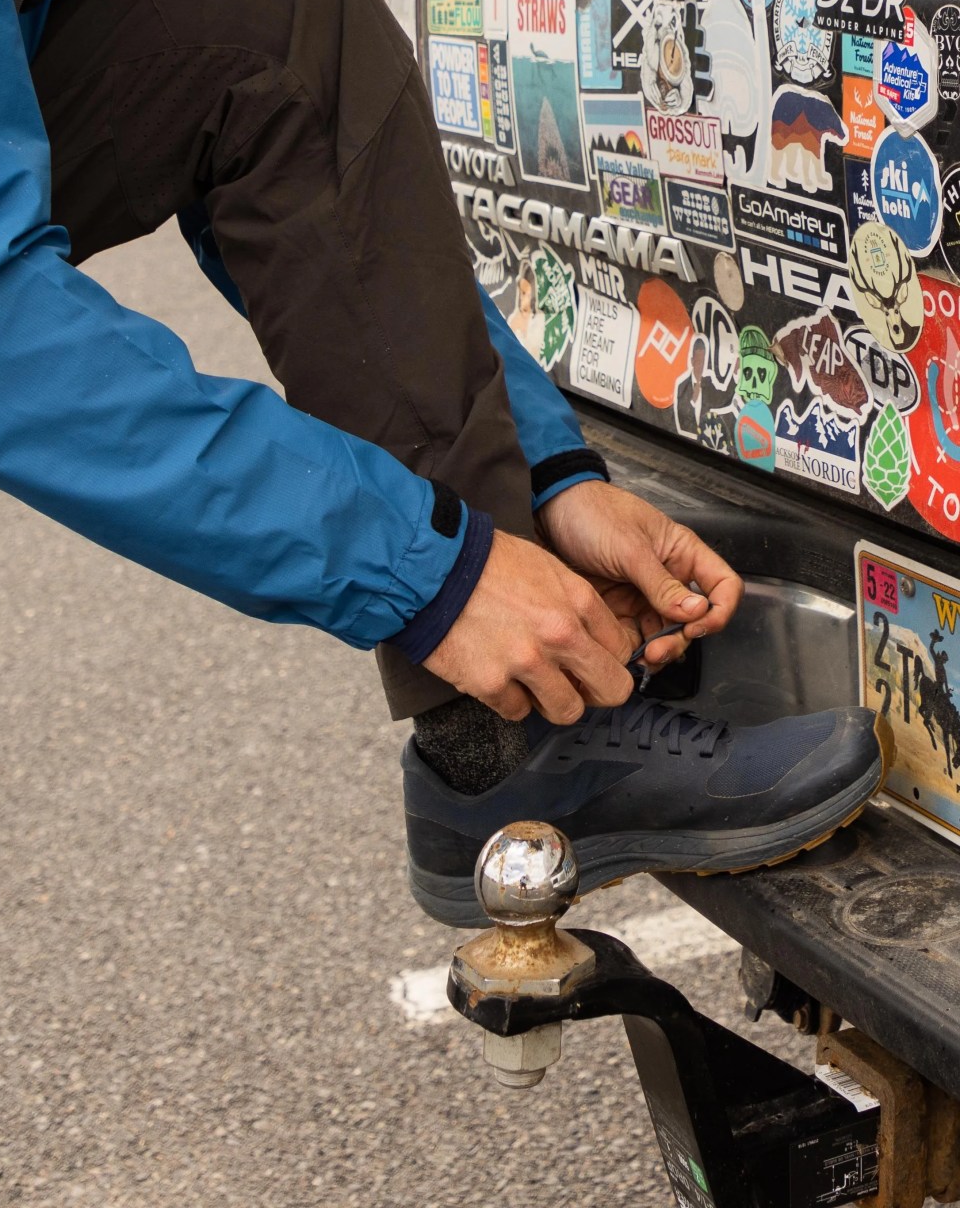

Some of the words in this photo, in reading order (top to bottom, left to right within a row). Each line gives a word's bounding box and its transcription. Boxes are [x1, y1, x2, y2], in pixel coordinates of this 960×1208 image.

[816, 15, 859, 32] WONDER
[865, 24, 903, 40] ALPINE
[431, 42, 475, 75] POWDER
[883, 61, 917, 80] Adventure
[437, 70, 451, 98] TO
[452, 74, 472, 103] THE
[883, 72, 912, 89] Medical
[903, 89, 915, 101] Kits
[649, 114, 717, 149] GROSSOUT
[850, 111, 877, 128] National
[853, 125, 874, 141] Forest
[441, 140, 516, 186] TOYOTA
[597, 156, 623, 176] Magic
[625, 160, 655, 180] Valley
[880, 159, 909, 193] ski
[609, 179, 655, 211] GEAR
[681, 190, 711, 213] RIDE
[881, 195, 911, 219] hoth
[672, 205, 730, 236] WYOMING
[738, 193, 836, 239] GoAmateur
[451, 181, 699, 283] TACOMAMA
[578, 251, 628, 304] MiiR
[589, 296, 618, 320] WALLS
[587, 314, 605, 334] ARE
[581, 347, 600, 368] FOR
[584, 331, 615, 355] MEANT
[801, 325, 844, 376] LEAP
[579, 366, 622, 395] CLIMBING
[848, 337, 911, 398] TDP
[776, 447, 800, 461] ACKSON
[784, 458, 801, 470] HOLE
[801, 454, 856, 490] NORDIC
[866, 564, 877, 601] 5
[896, 644, 914, 725] T
